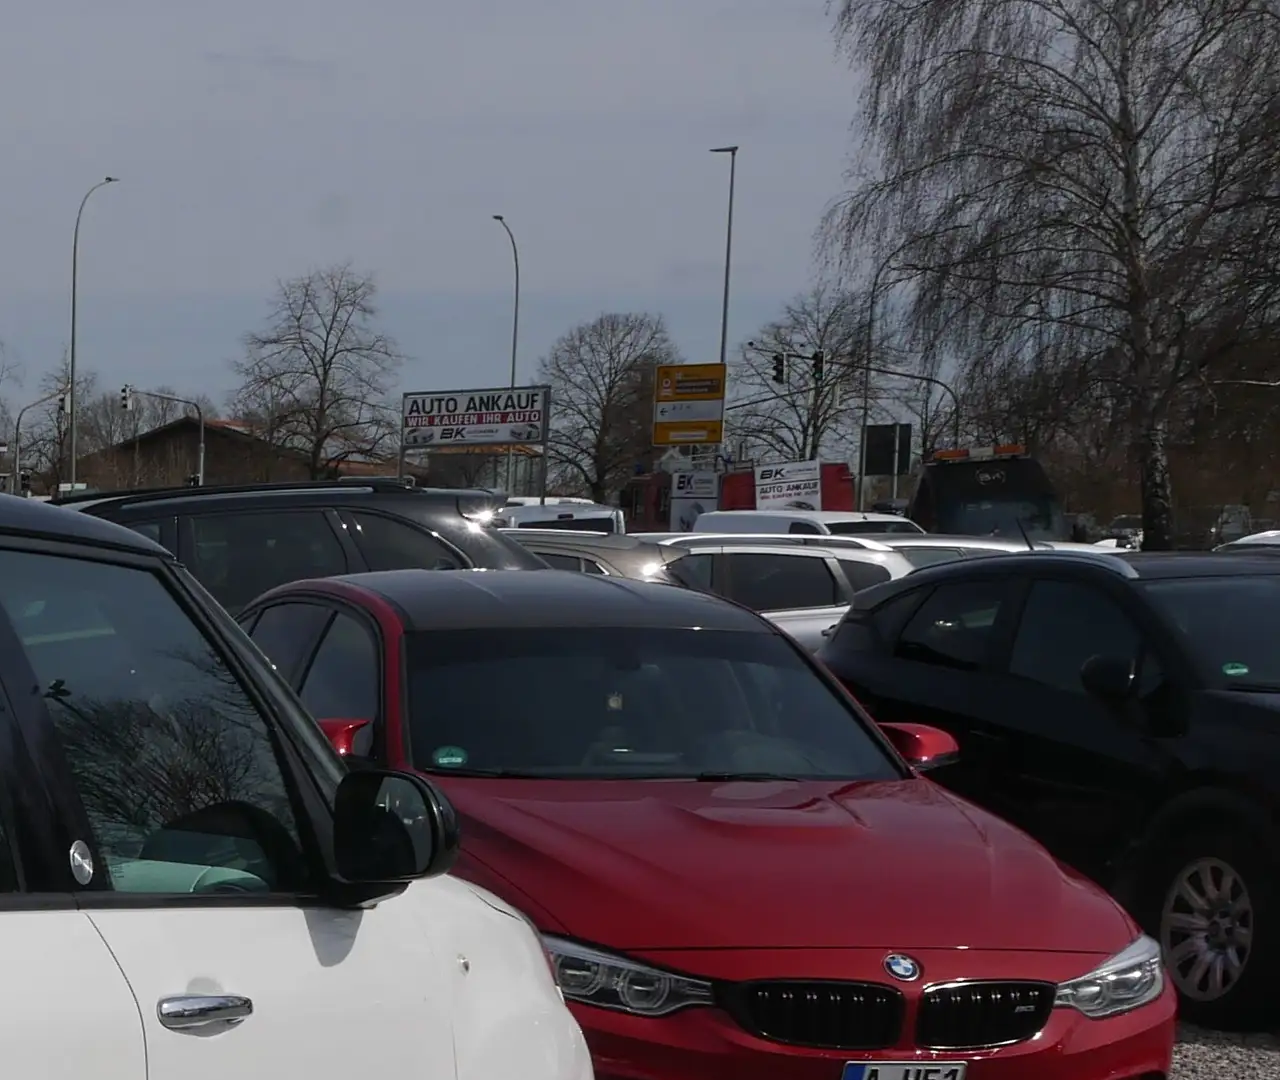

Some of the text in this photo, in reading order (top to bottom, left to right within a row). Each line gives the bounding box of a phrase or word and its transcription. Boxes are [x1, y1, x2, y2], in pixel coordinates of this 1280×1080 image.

[409, 393, 540, 415] AUTO ANKAUF
[407, 411, 539, 427] WIR KAUFEN IHR AUTO
[440, 427, 466, 440] BK
[760, 468, 785, 480] BK
[677, 475, 694, 490] BK
[759, 482, 818, 494] AUTO ANKAUF
